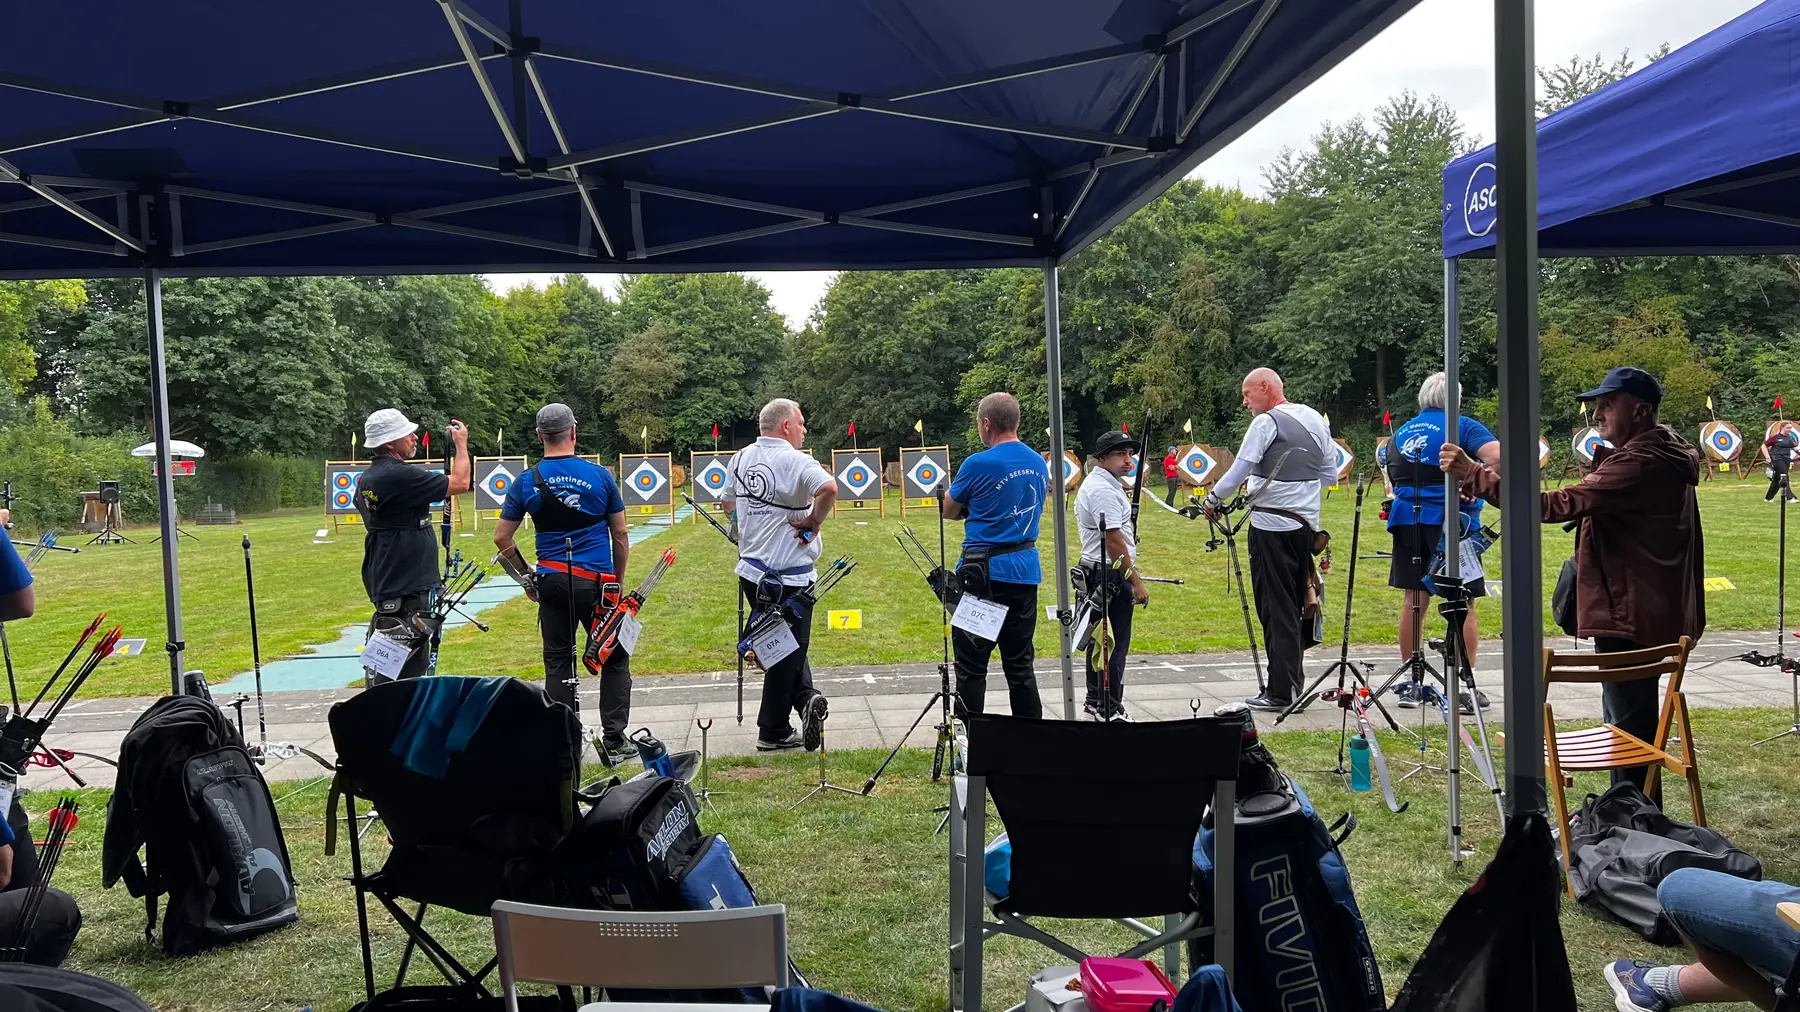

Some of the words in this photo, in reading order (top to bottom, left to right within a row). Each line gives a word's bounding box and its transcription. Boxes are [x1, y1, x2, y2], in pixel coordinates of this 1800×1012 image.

[548, 475, 593, 490] Göttingen
[995, 476, 1009, 491] MTV
[1009, 468, 1035, 479] SEESEN
[839, 615, 849, 627] 7
[970, 609, 986, 621] 07C
[766, 638, 780, 650] 07A
[376, 648, 389, 660] 06A
[213, 798, 256, 896] AVALON
